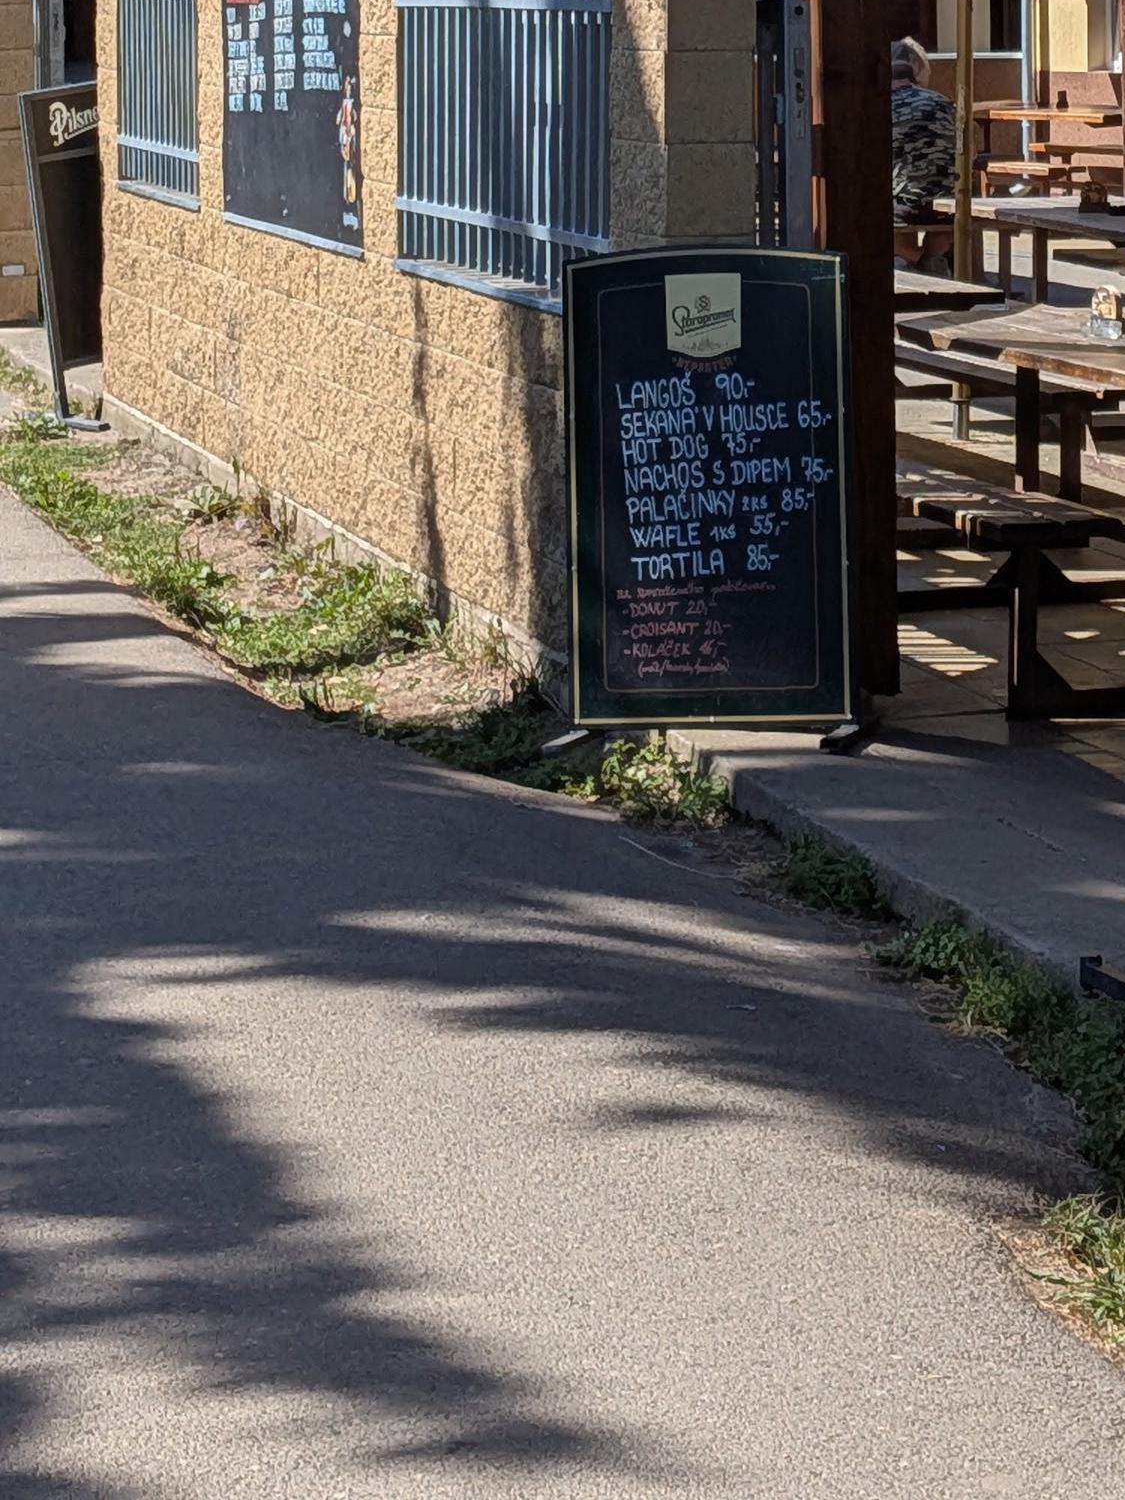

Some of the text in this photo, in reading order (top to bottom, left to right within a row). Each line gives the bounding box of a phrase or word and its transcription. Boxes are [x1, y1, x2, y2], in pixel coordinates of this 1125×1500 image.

[615, 371, 697, 411] LANGOŠ
[620, 405, 699, 439] SEKANÁ
[702, 405, 714, 432] V
[719, 401, 790, 433] HOUSCE
[621, 437, 662, 467] HOT
[668, 432, 709, 461] DOG
[624, 460, 706, 496] NACHOS
[712, 459, 726, 486] S
[730, 456, 792, 487] DIPEM
[625, 488, 736, 525] PALAČINKY
[629, 521, 702, 550] WAFLE
[630, 547, 725, 582] TORTILA
